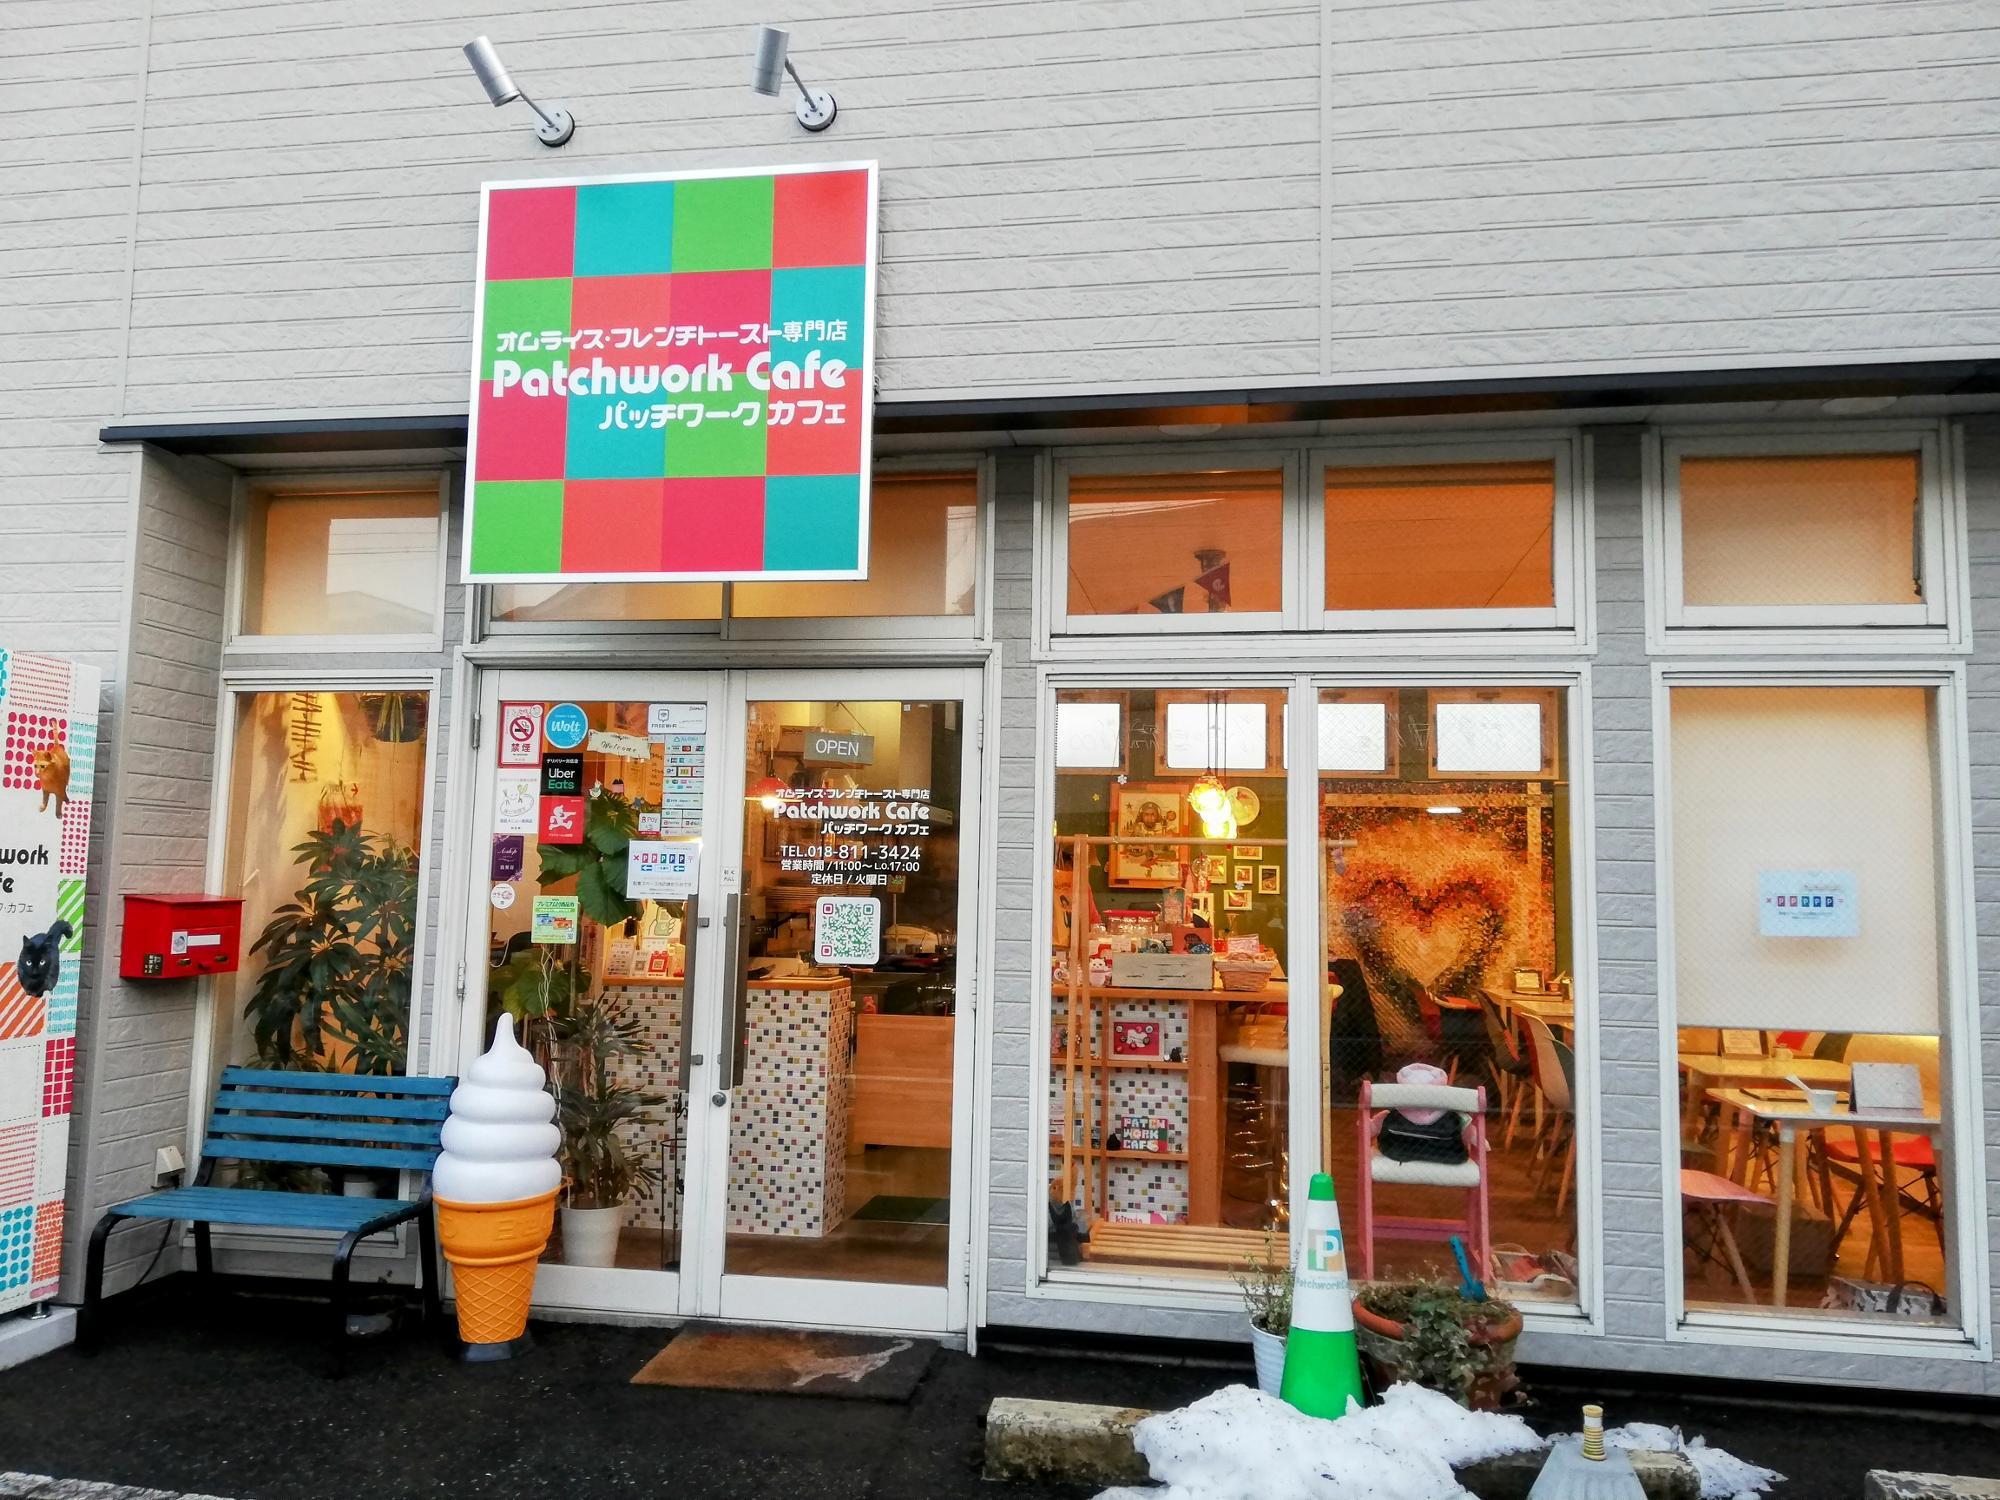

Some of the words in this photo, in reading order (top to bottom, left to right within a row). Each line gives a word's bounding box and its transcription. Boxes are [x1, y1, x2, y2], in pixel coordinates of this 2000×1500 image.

[496, 319, 848, 352] オムライス・フレンチトースト専門店
[492, 353, 733, 398] Patchwork
[746, 349, 848, 391] Cafe
[598, 400, 761, 430] パッチワーク
[766, 399, 847, 426] カフェ
[551, 719, 581, 733] Wolt
[510, 743, 531, 753] 禁煙
[815, 738, 860, 757] OPEN
[548, 767, 576, 779] Uber
[548, 779, 575, 790] Eats
[775, 788, 931, 799] オムライス・フレンチトースト専門店
[773, 801, 881, 820] Patchwork
[885, 802, 930, 820] Cafe
[820, 821, 892, 835] パッチワーク
[894, 824, 930, 836] カフェ
[780, 844, 921, 860] TEL.018-811-3424
[780, 859, 825, 871] 営業時間
[811, 873, 844, 885] 定休日
[855, 874, 888, 886] 火曜日
[1123, 1118, 1166, 1128] PATCH
[1123, 1129, 1159, 1139] WORK
[1314, 1234, 1339, 1269] P
